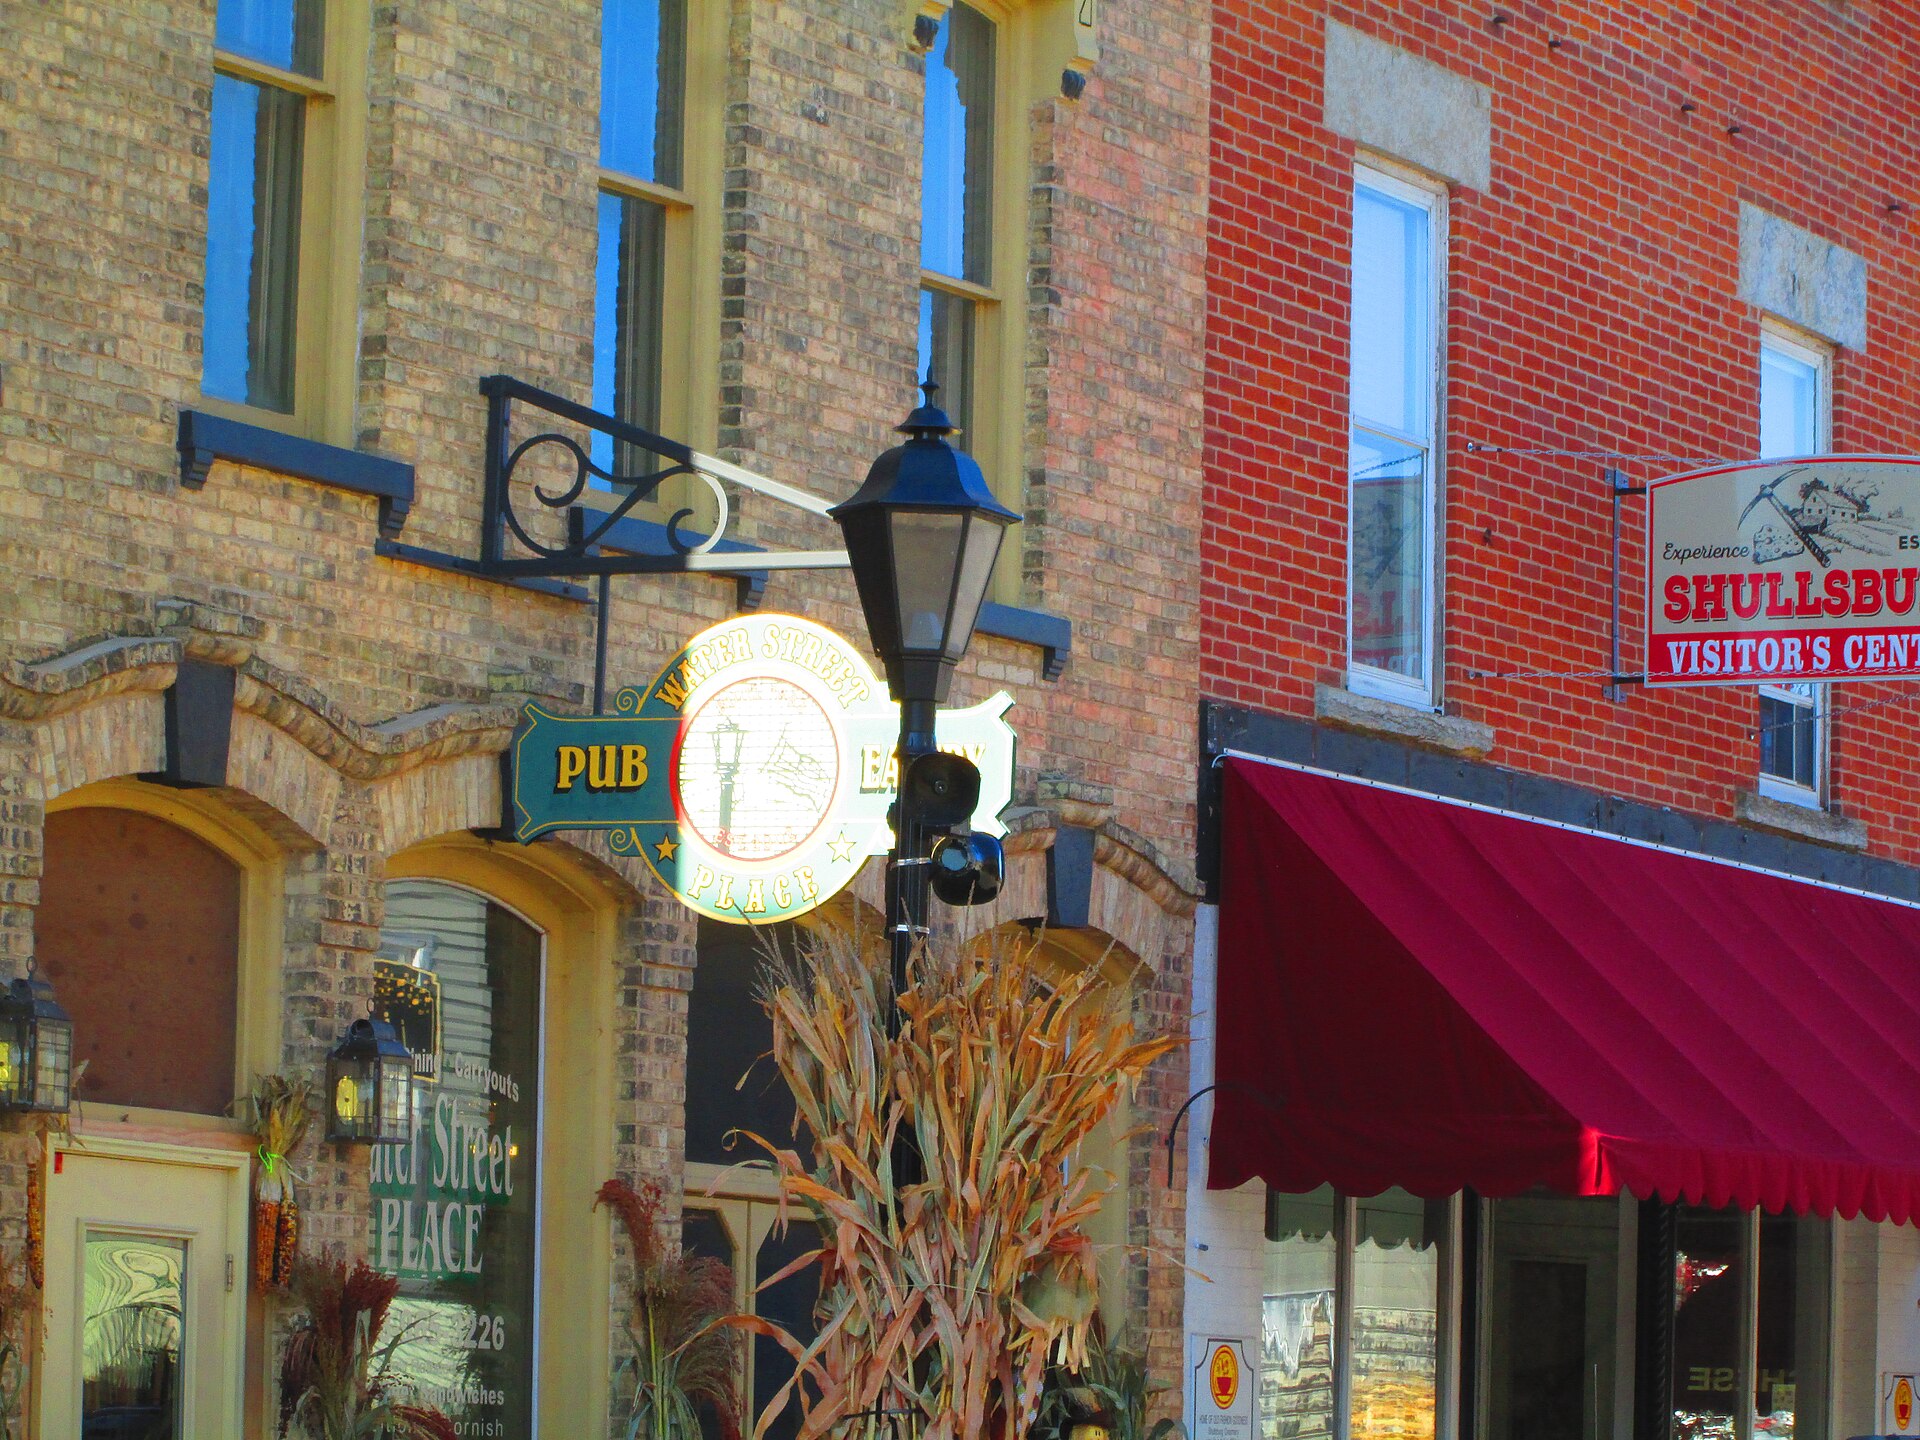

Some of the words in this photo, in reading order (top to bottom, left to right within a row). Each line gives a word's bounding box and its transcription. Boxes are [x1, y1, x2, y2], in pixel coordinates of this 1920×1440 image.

[1663, 541, 1749, 565] Experience
[1664, 568, 1920, 623] SHULLSBU
[654, 628, 753, 711] WATER
[761, 624, 870, 709] STREET
[1667, 635, 1831, 673] VISITOR'S
[556, 744, 648, 791] PUB
[687, 864, 819, 913] PLACE
[455, 1052, 519, 1102] Carryouts
[433, 1093, 514, 1196] Street
[379, 1199, 483, 1273] PLACE
[453, 1419, 503, 1436] ornish
